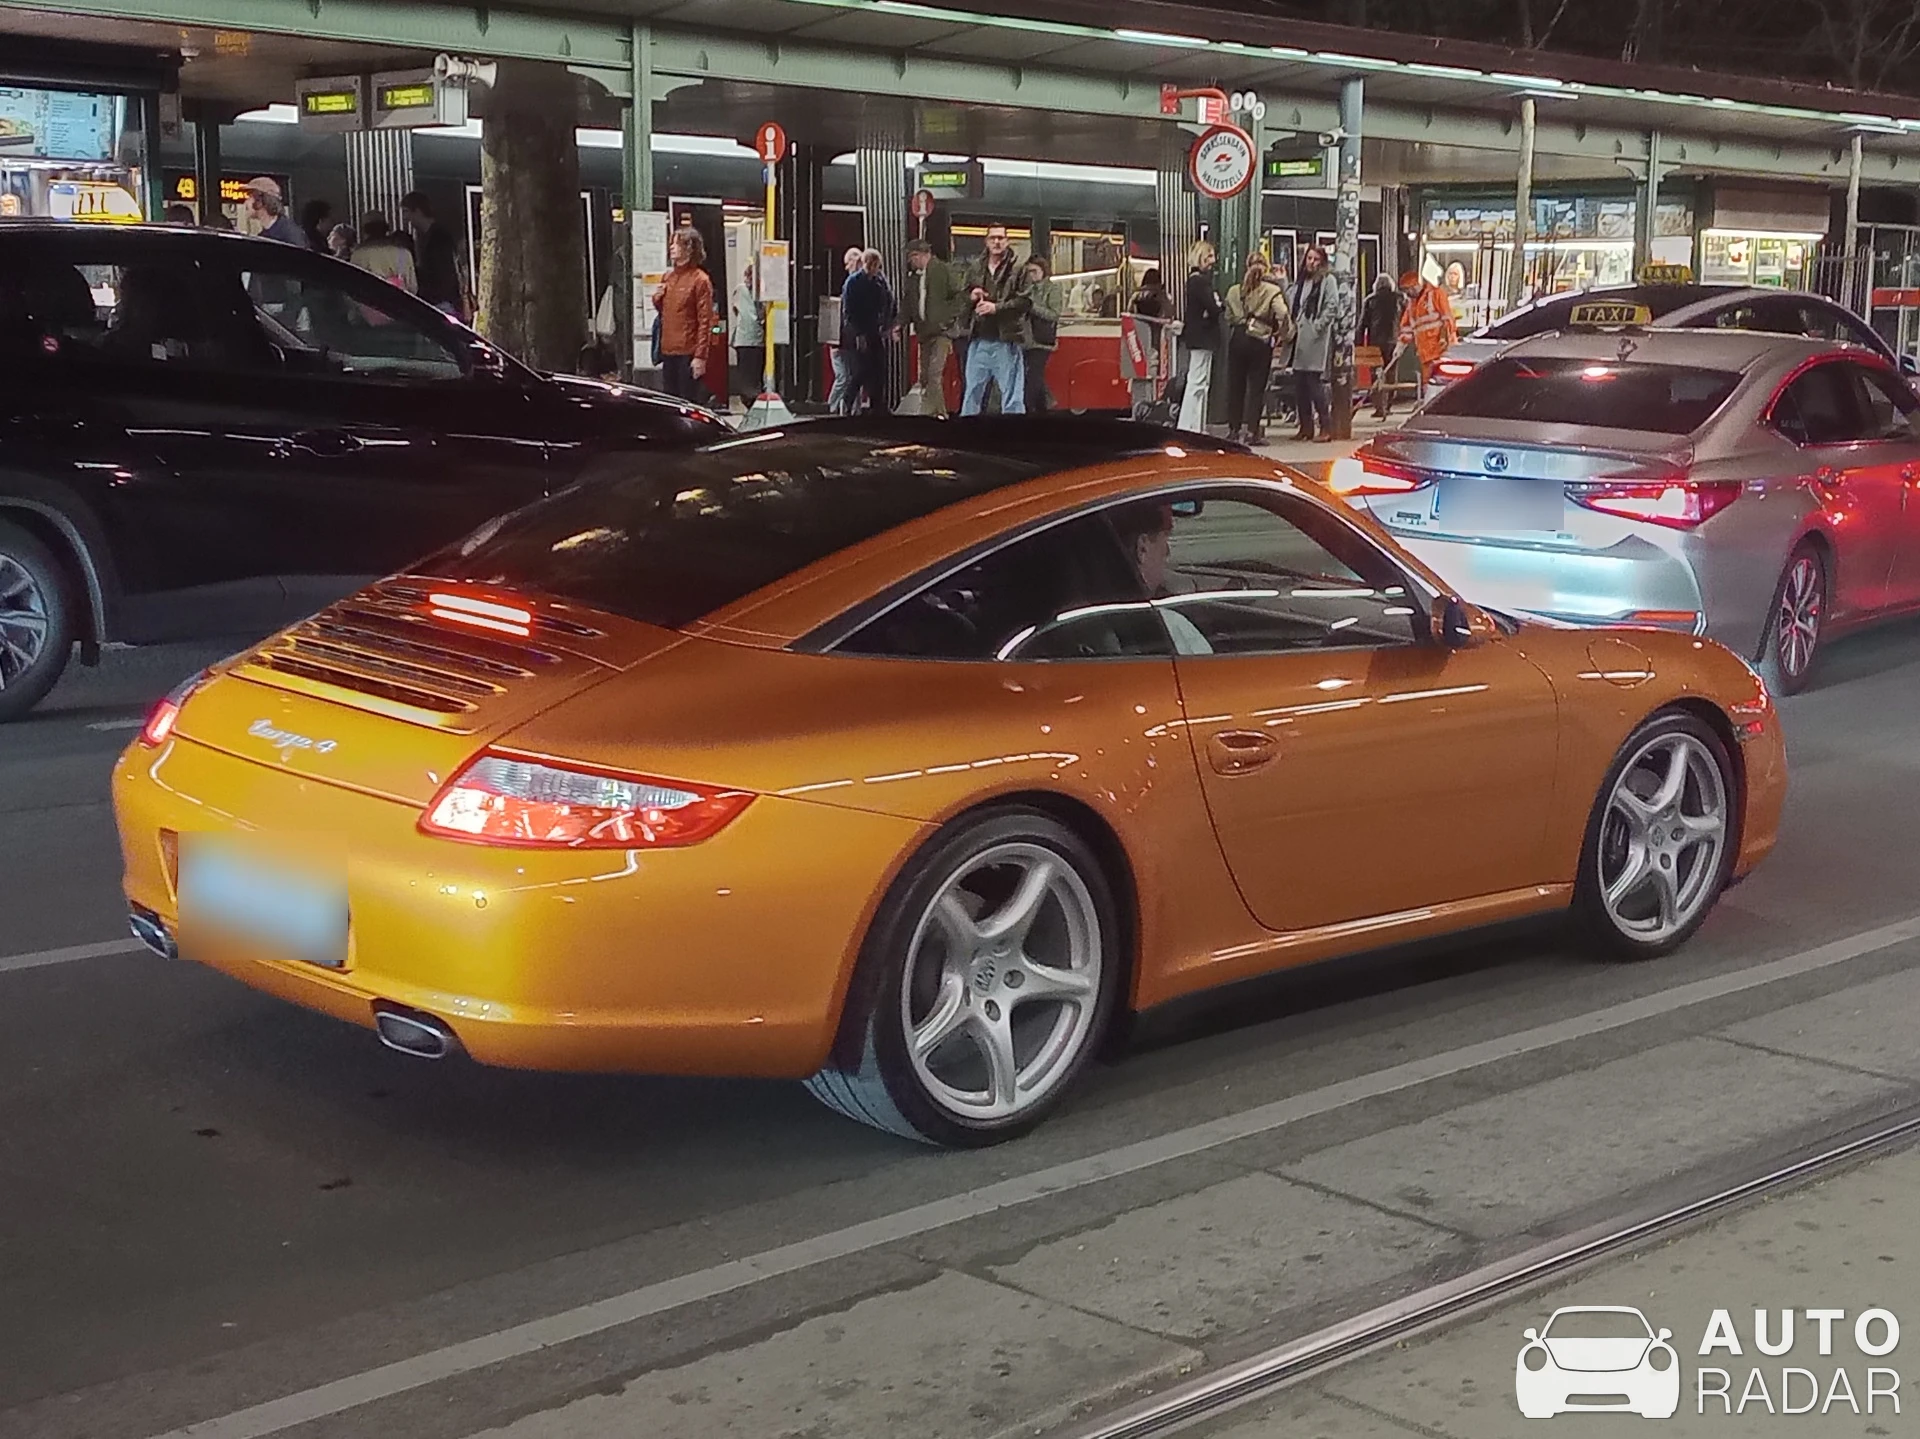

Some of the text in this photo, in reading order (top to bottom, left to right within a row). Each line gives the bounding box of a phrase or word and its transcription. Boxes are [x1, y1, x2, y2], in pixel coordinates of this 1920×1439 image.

[177, 178, 195, 198] 49
[1201, 169, 1244, 190] HALTESTELLE
[1586, 307, 1628, 321] TAXI
[315, 740, 338, 753] 4
